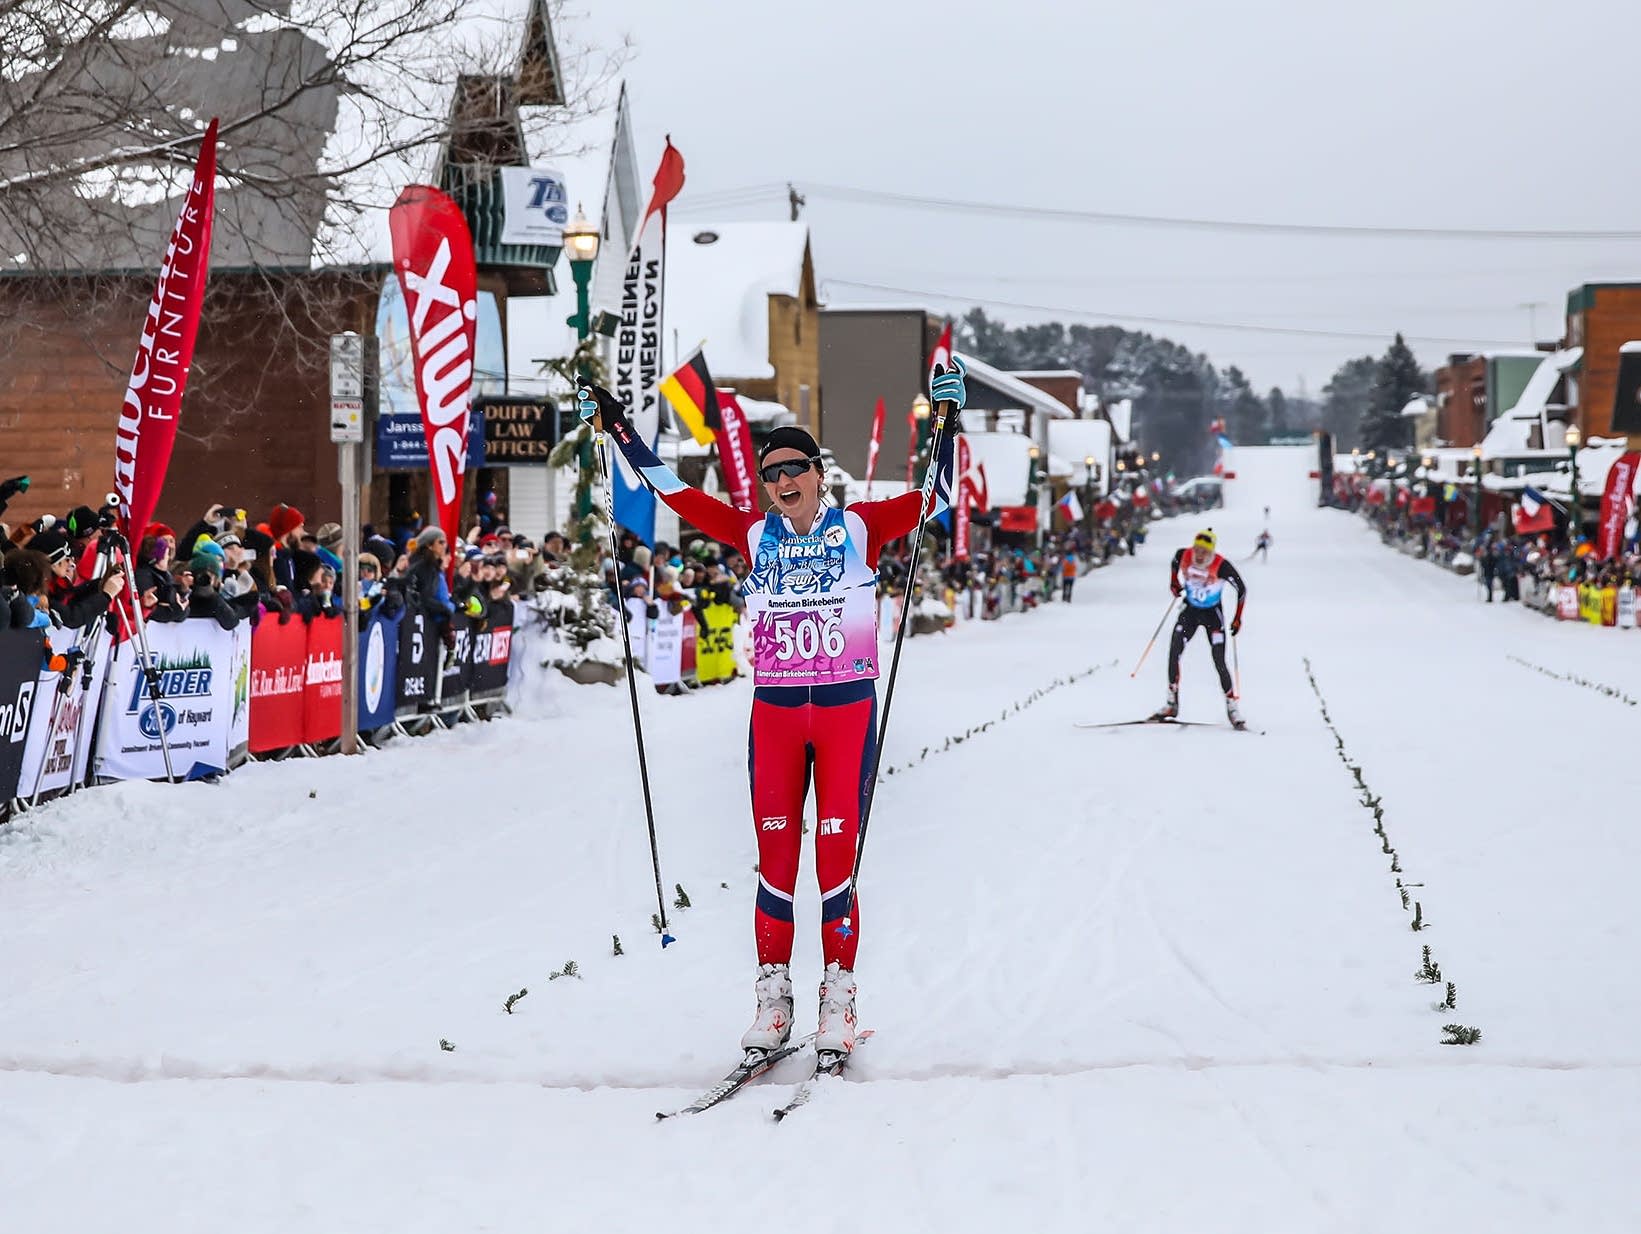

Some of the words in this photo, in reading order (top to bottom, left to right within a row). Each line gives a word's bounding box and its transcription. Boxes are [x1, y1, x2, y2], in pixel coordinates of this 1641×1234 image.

[148, 180, 204, 421] FURNITURE
[485, 405, 545, 420] DUFFY
[386, 421, 425, 433] Janss
[495, 423, 535, 437] LAW
[484, 441, 549, 455] OFFICES
[768, 600, 800, 608] American
[802, 596, 846, 607] Birkebeiner
[775, 616, 846, 660] 506
